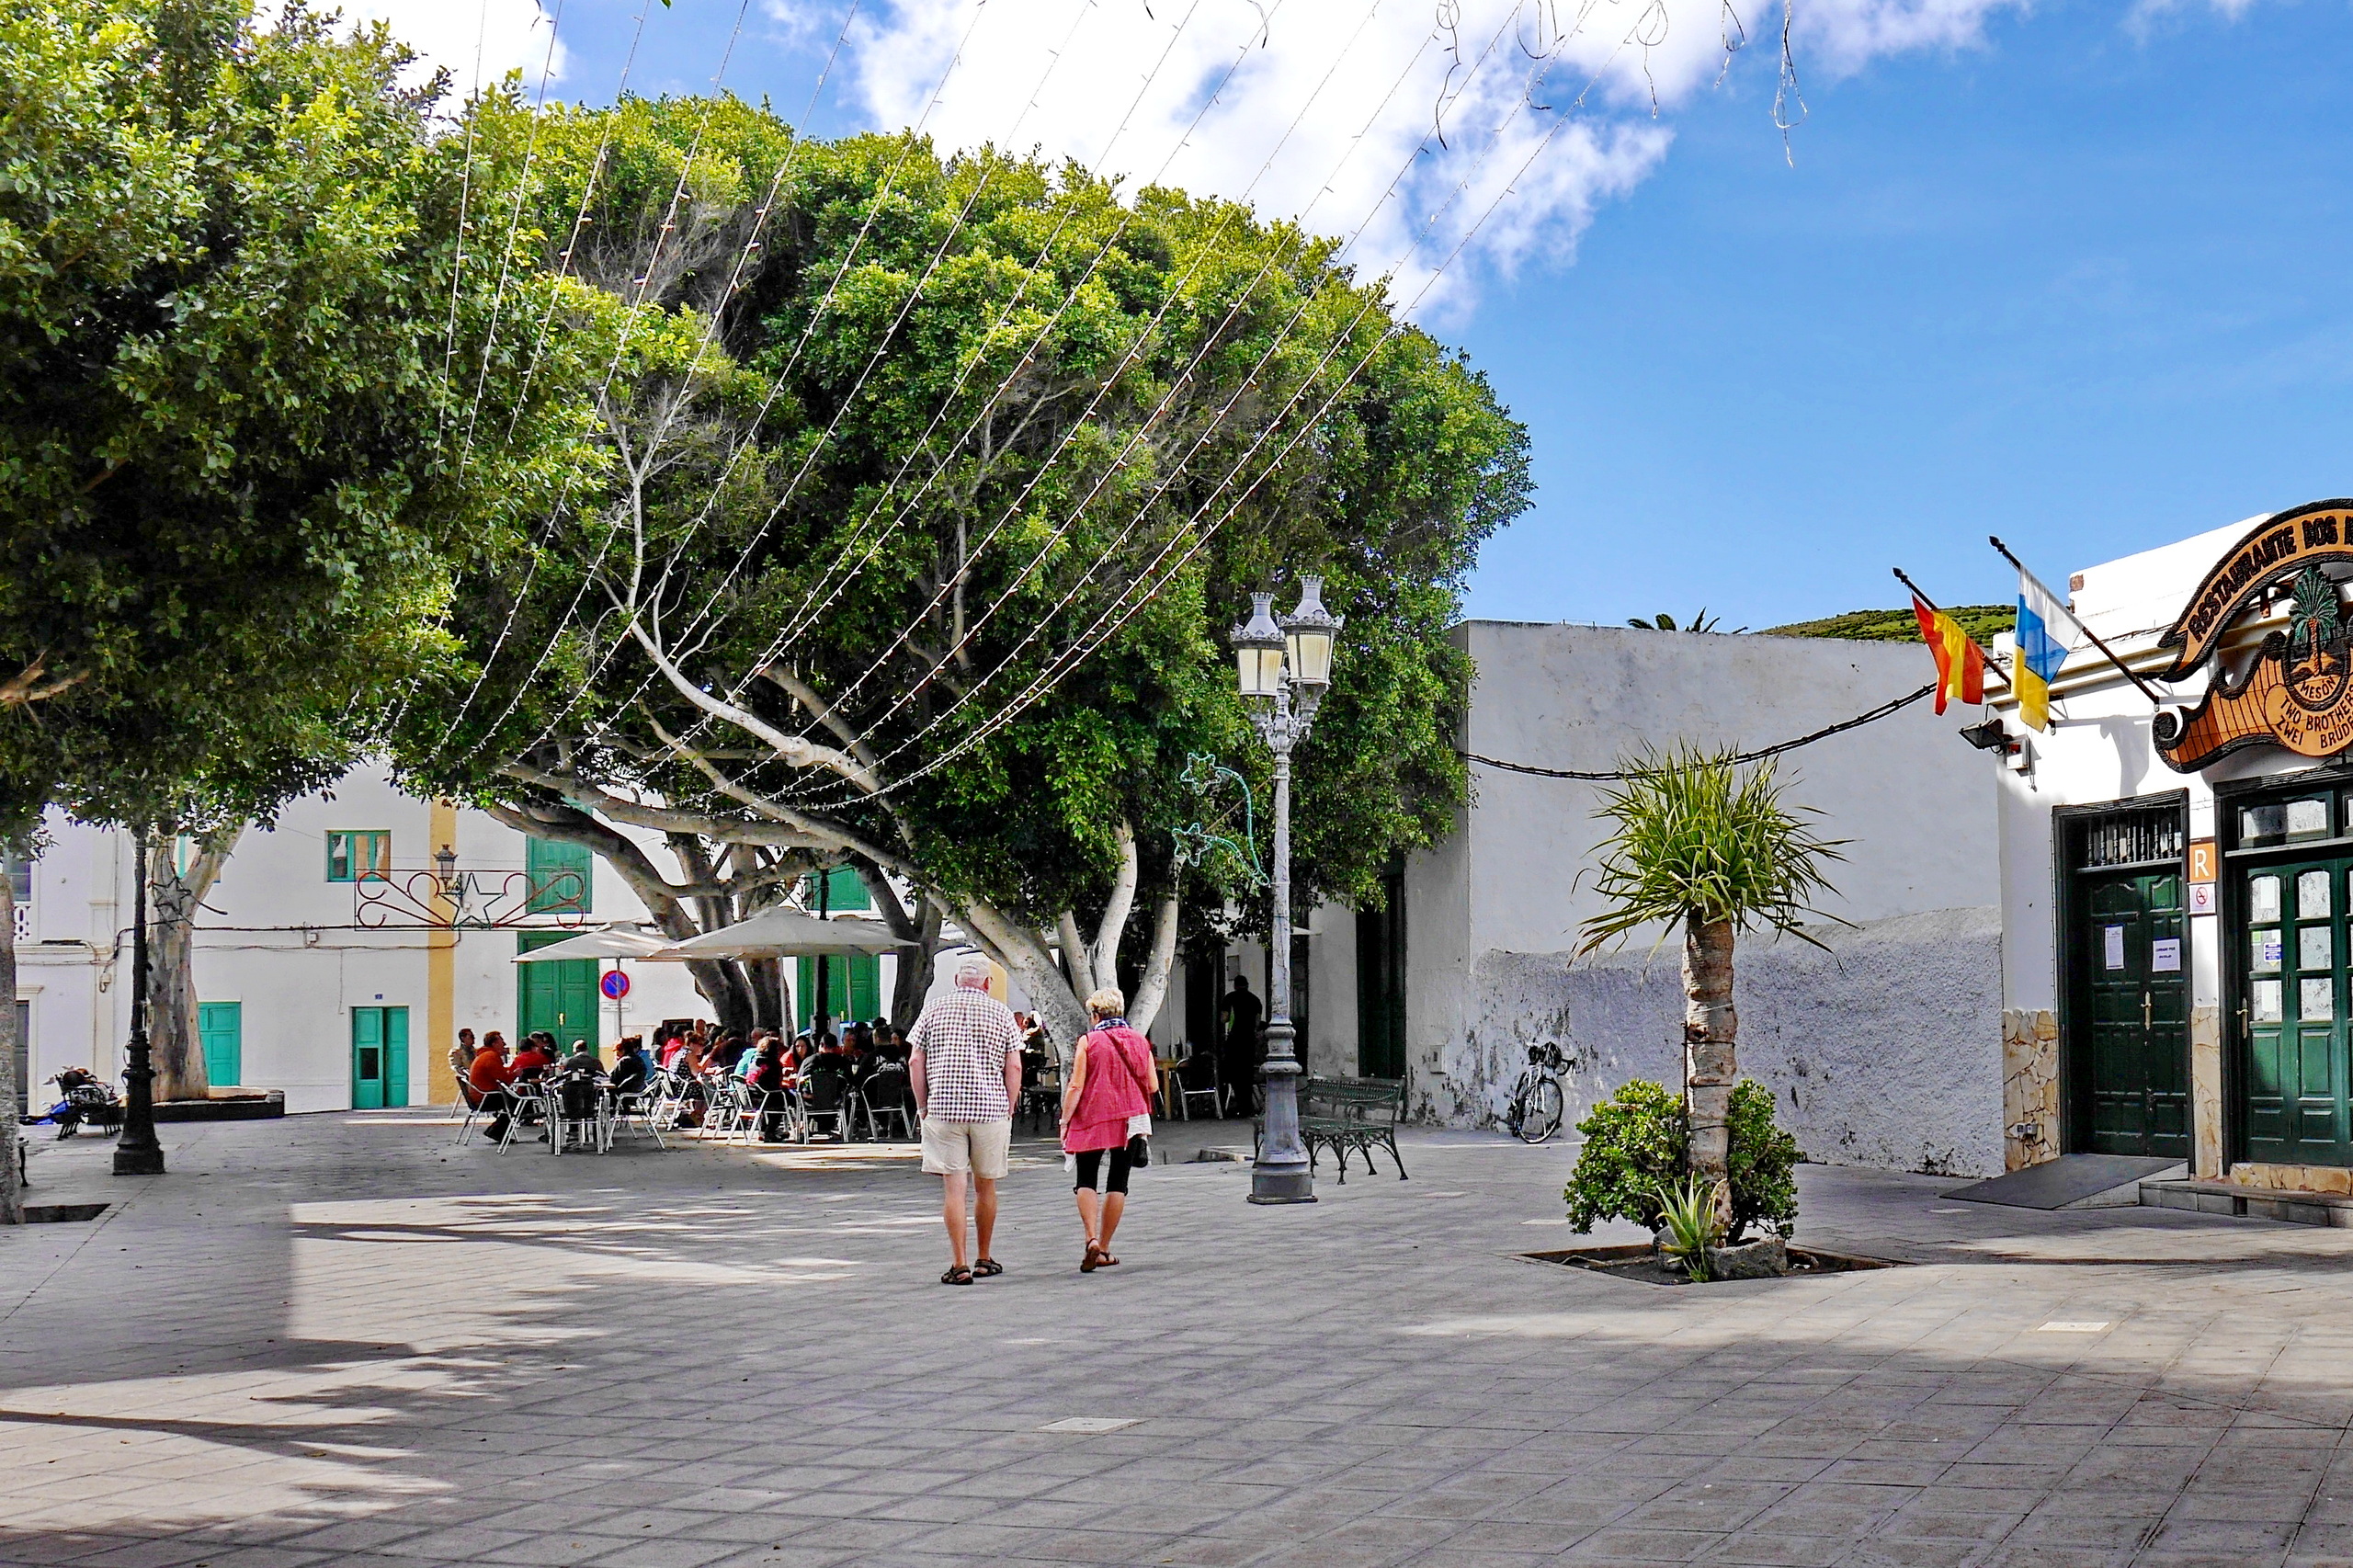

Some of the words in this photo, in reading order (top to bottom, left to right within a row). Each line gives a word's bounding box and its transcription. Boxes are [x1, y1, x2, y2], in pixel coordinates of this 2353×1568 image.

[2187, 526, 2297, 643] RESTAURANTE
[2302, 516, 2338, 550] DOS
[2300, 676, 2336, 699] MESÓN
[2280, 695, 2302, 724] TWO
[2276, 714, 2304, 745] ZWEI
[2320, 713, 2353, 749] BRÜDE
[2194, 848, 2210, 878] R
